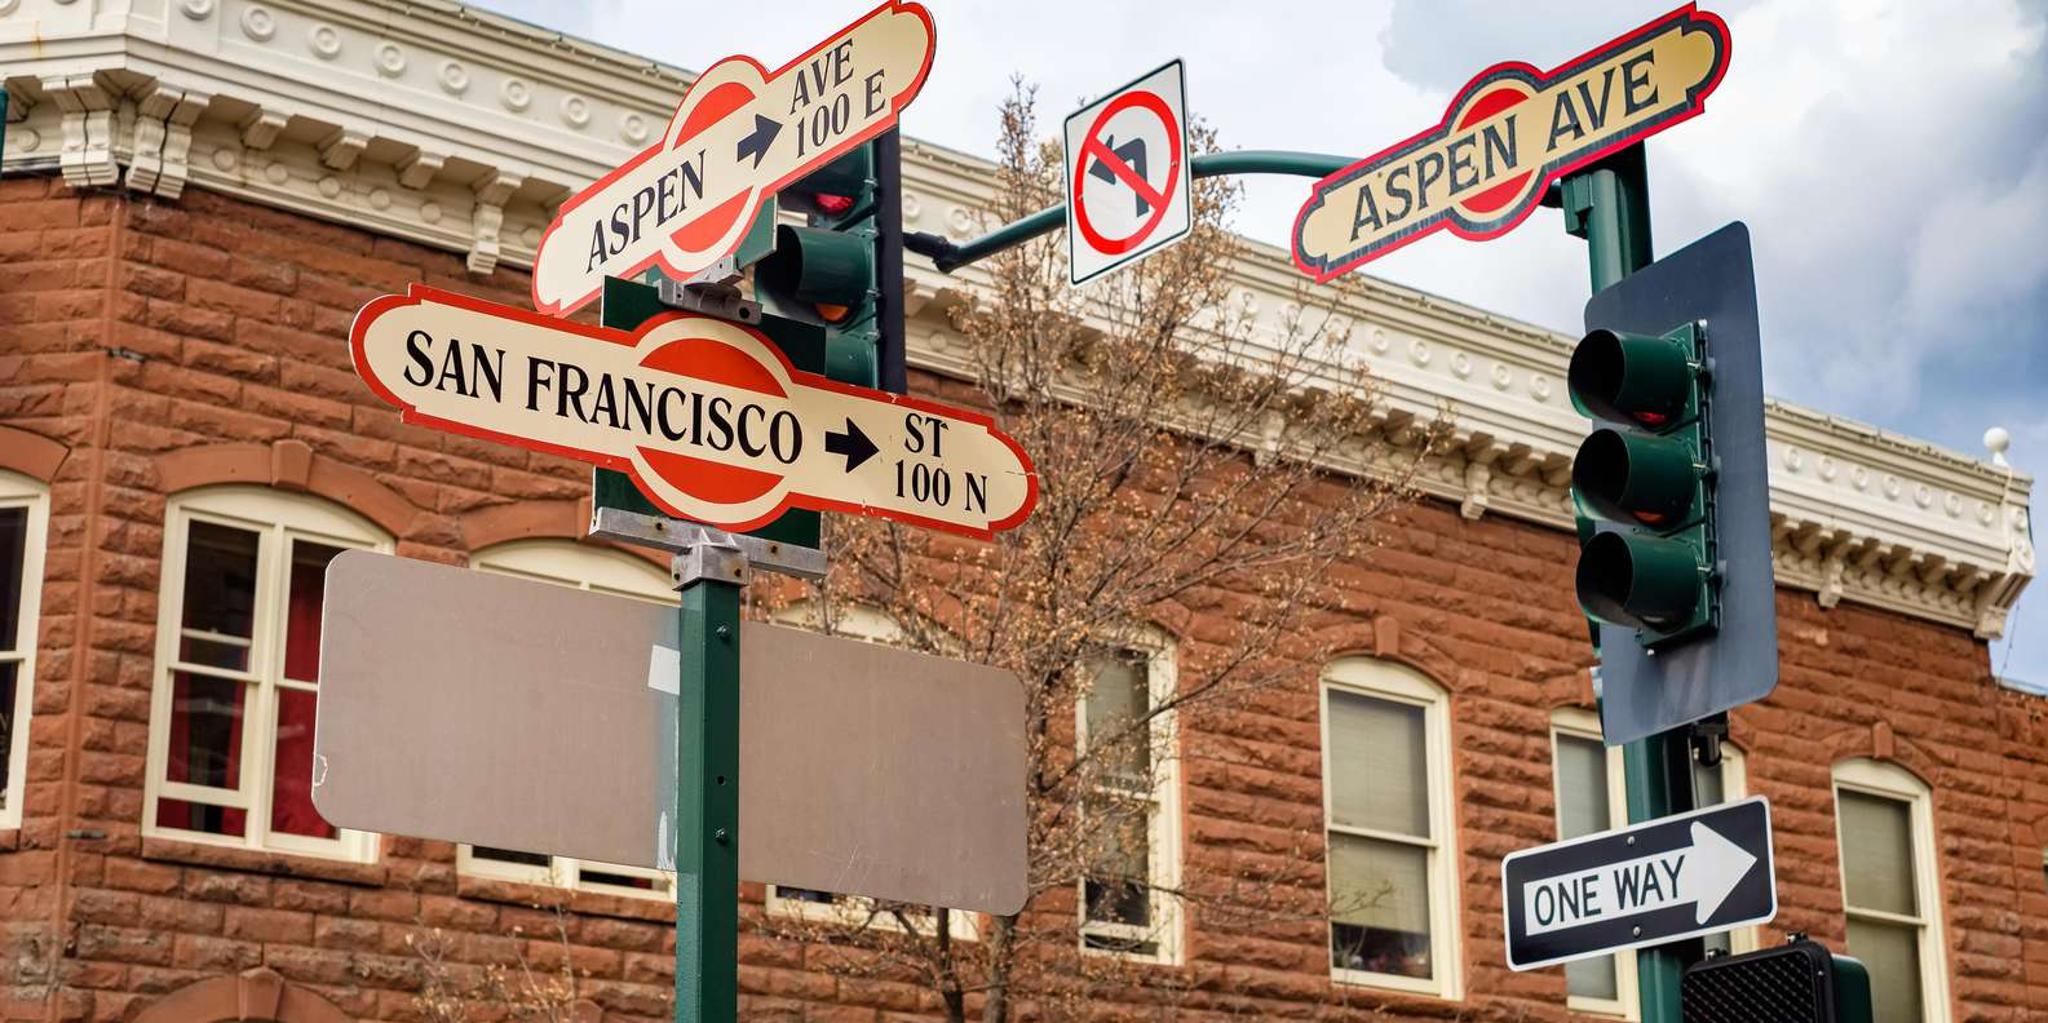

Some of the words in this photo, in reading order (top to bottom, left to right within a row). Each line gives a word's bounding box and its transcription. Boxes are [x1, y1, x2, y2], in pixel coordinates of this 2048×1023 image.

[789, 39, 854, 114] AVE
[796, 93, 850, 158] 100
[864, 69, 886, 117] E
[1350, 115, 1518, 242] ASPEN
[1546, 49, 1659, 153] AVE
[586, 150, 706, 274] ASPEN
[403, 329, 505, 404] SAN
[525, 356, 803, 464] FRANCISCO
[905, 413, 947, 457] ST
[895, 461, 950, 507] 100
[965, 473, 988, 514] N
[1534, 875, 1601, 926] ONE
[1614, 855, 1685, 910] WAY
